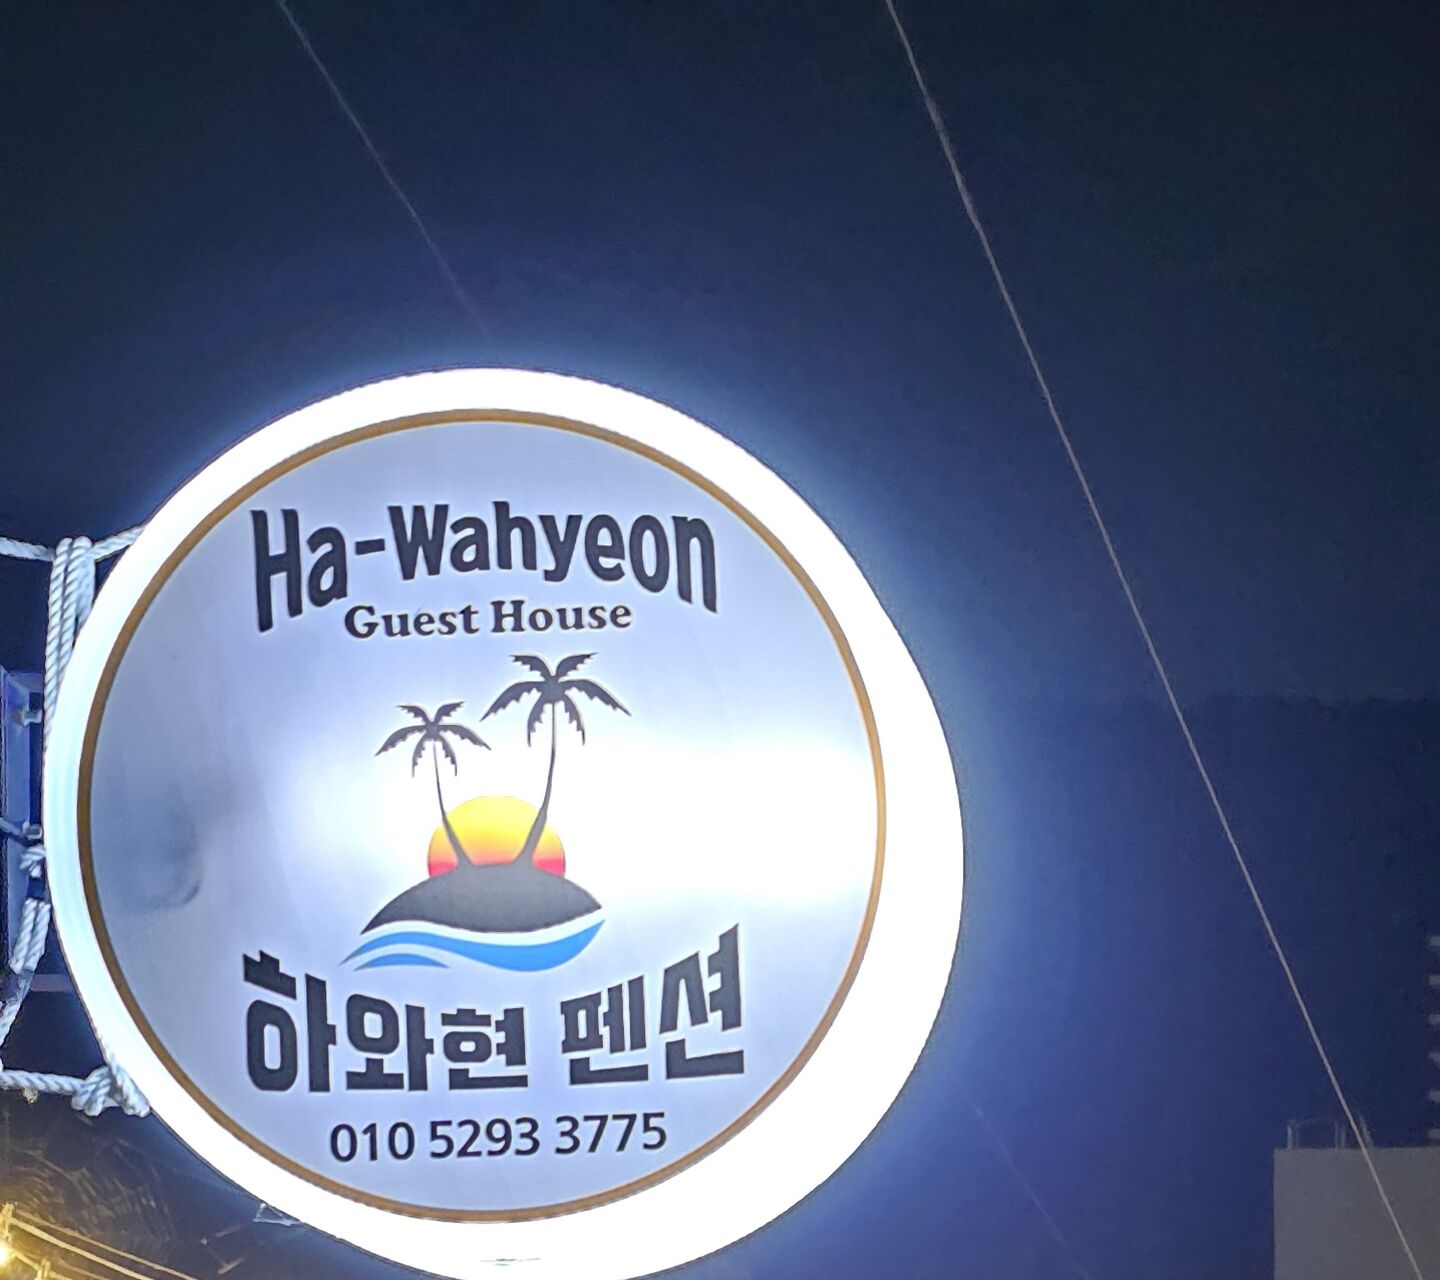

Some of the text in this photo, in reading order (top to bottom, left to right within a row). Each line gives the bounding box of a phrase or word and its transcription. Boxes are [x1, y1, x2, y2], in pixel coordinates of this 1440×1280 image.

[250, 500, 718, 633] Ha-Wahyeon
[344, 599, 631, 639] Guest House
[242, 923, 745, 1093] 하와현 펜션
[330, 1111, 667, 1163] 010 5293 3775
